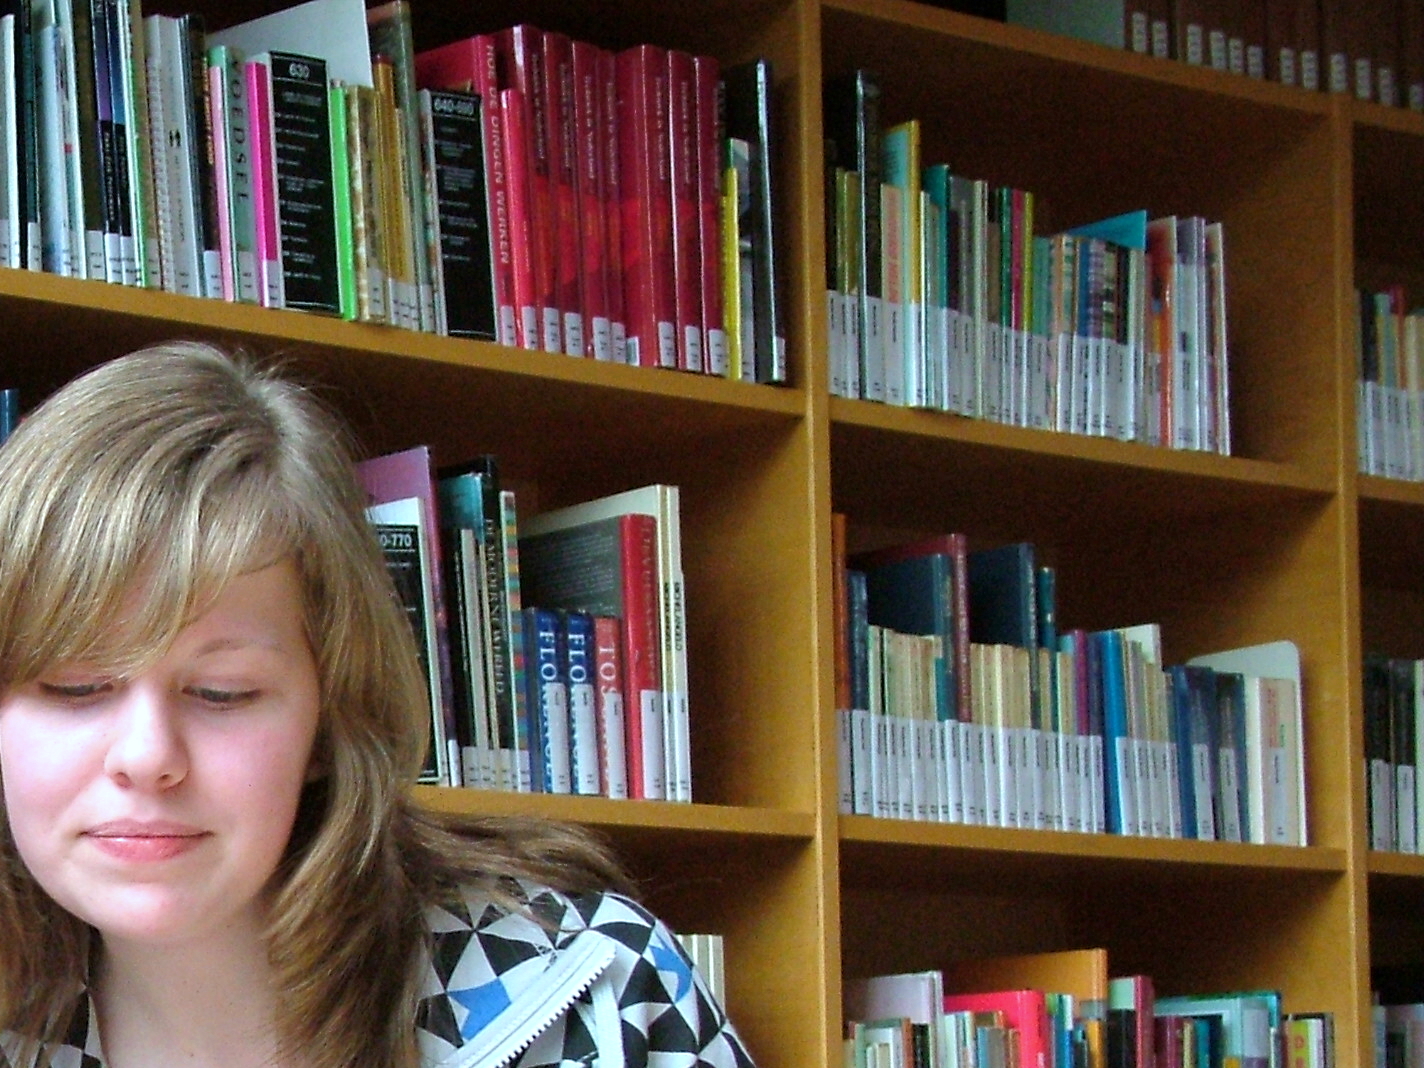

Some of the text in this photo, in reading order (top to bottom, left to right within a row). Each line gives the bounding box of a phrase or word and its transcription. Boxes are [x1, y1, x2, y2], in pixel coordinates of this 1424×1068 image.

[289, 62, 310, 80] 630
[486, 44, 509, 263] HOE DE DINGEN WERKEN
[376, 534, 413, 548] 0-770
